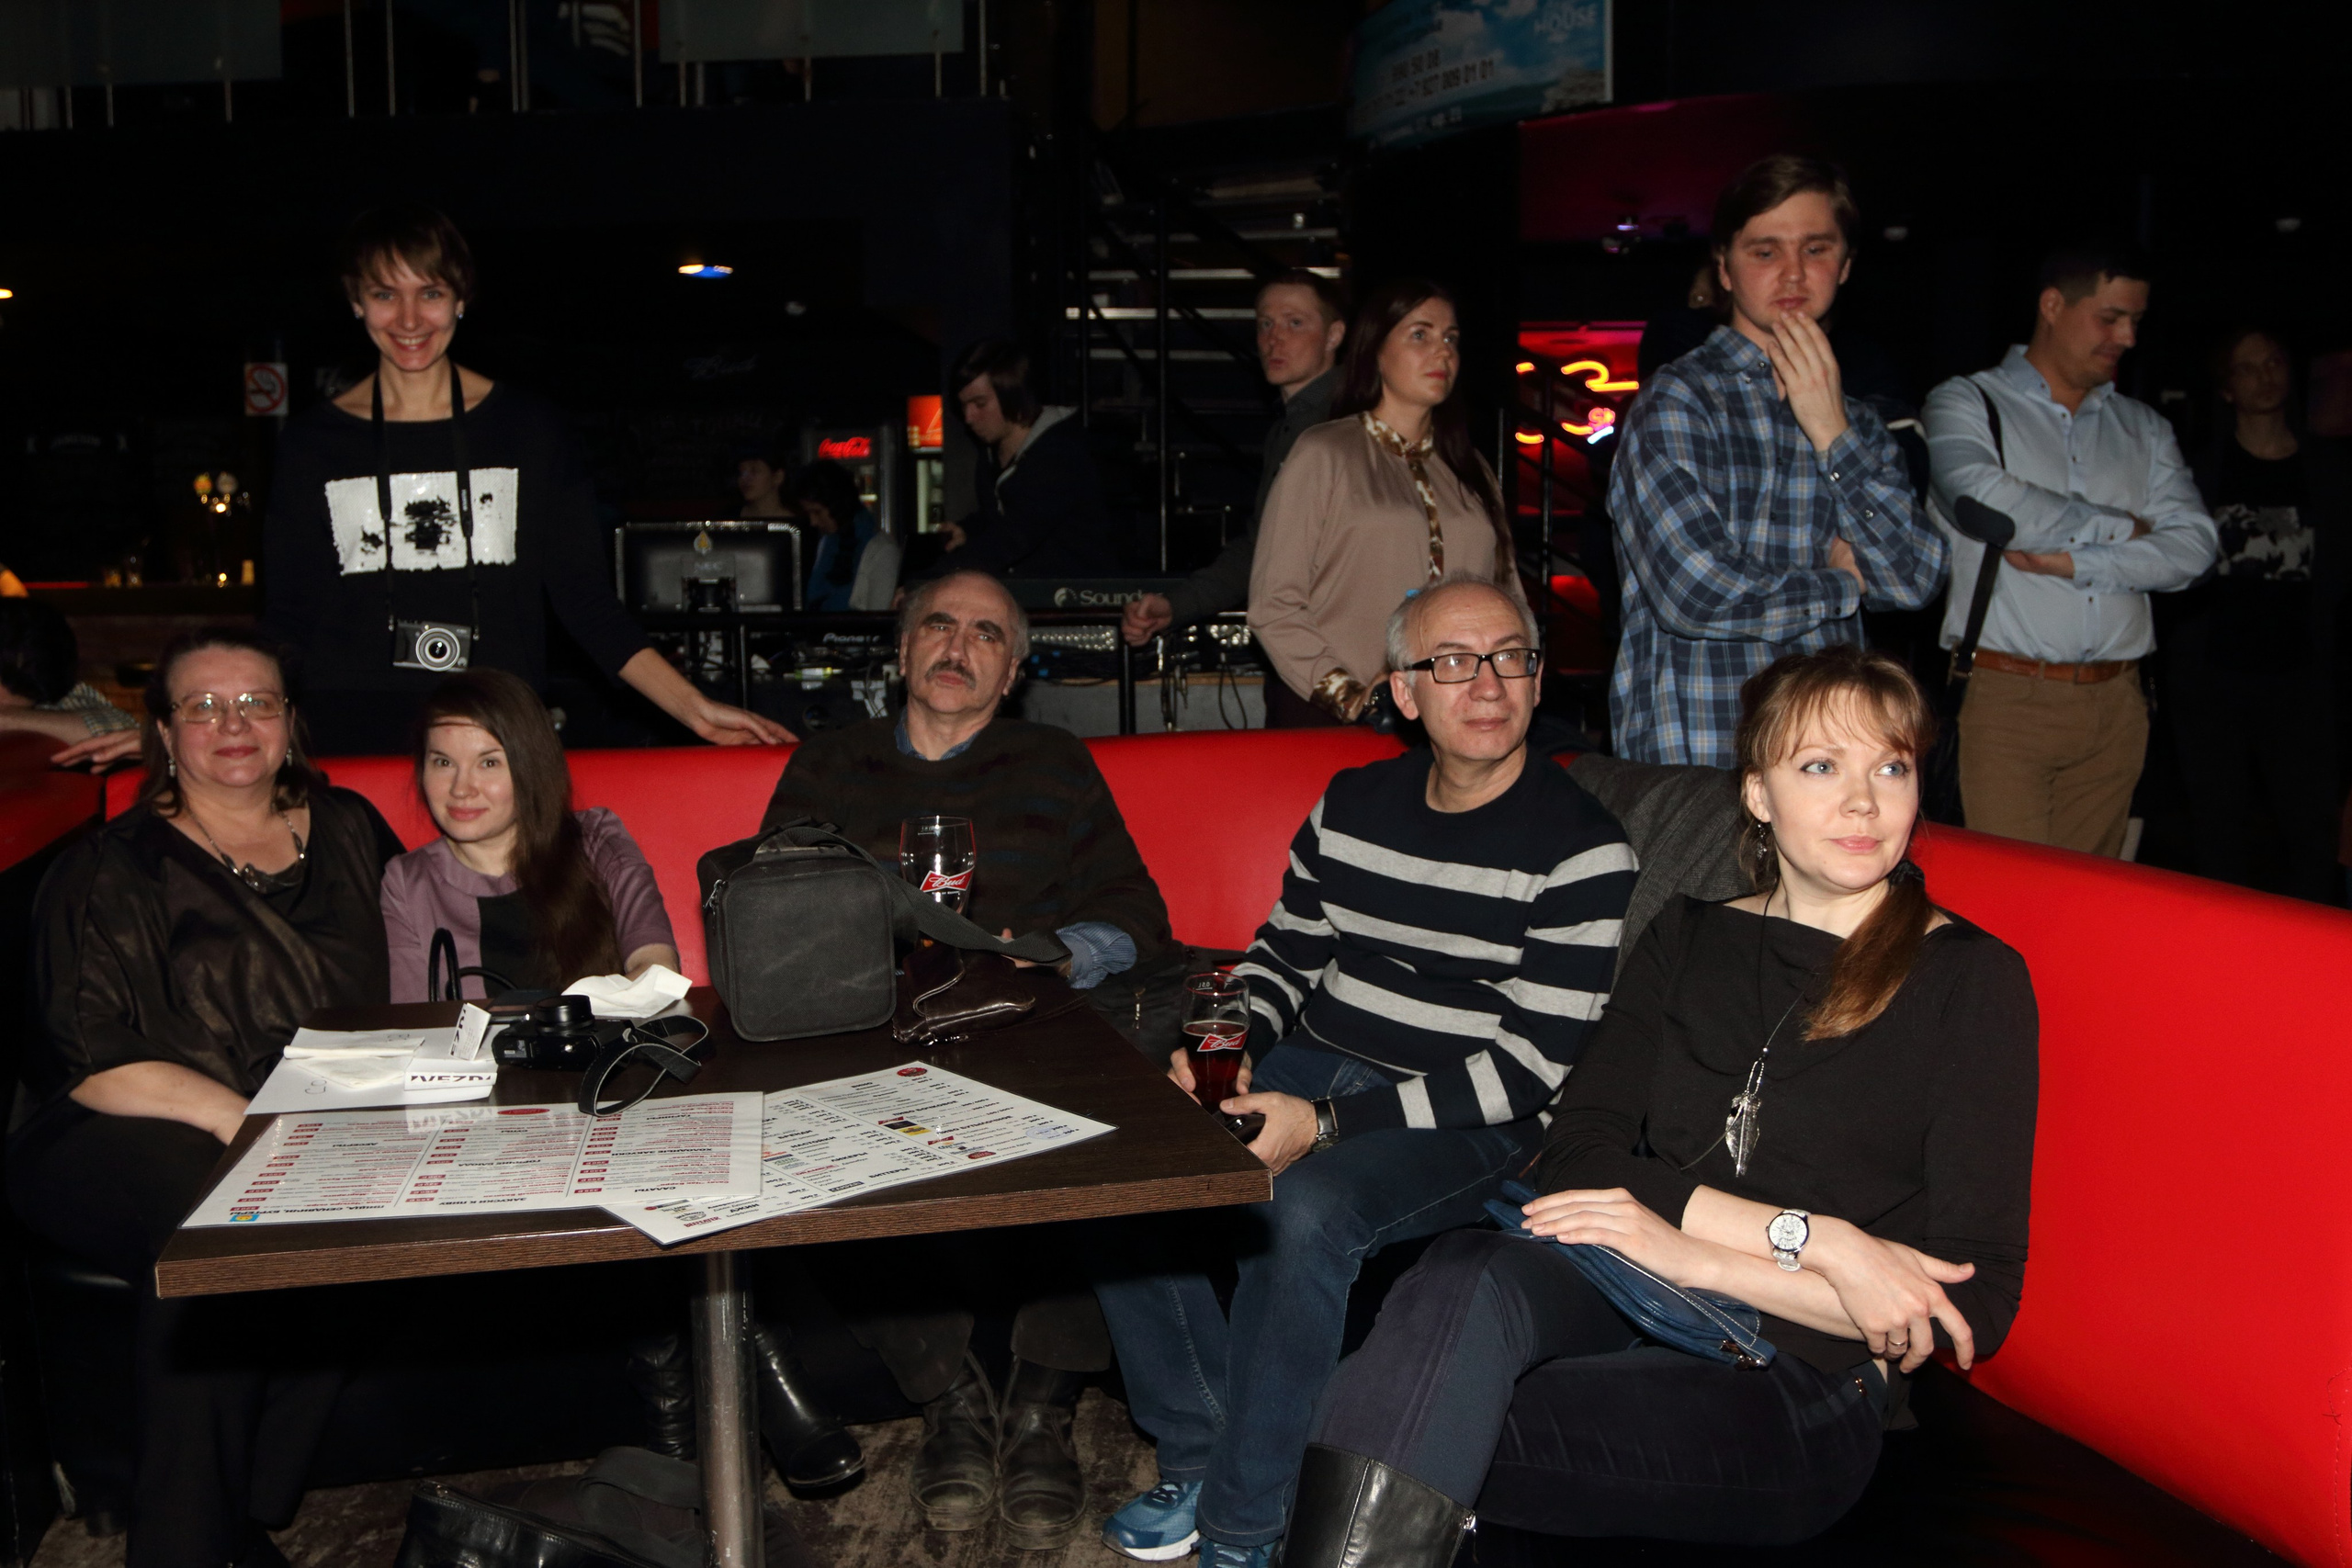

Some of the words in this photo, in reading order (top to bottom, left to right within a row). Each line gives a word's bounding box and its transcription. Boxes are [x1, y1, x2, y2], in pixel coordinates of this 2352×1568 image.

[929, 875, 966, 888] Bud
[1207, 1036, 1242, 1048] Bud
[868, 1167, 910, 1179] БИТТЕРЫ
